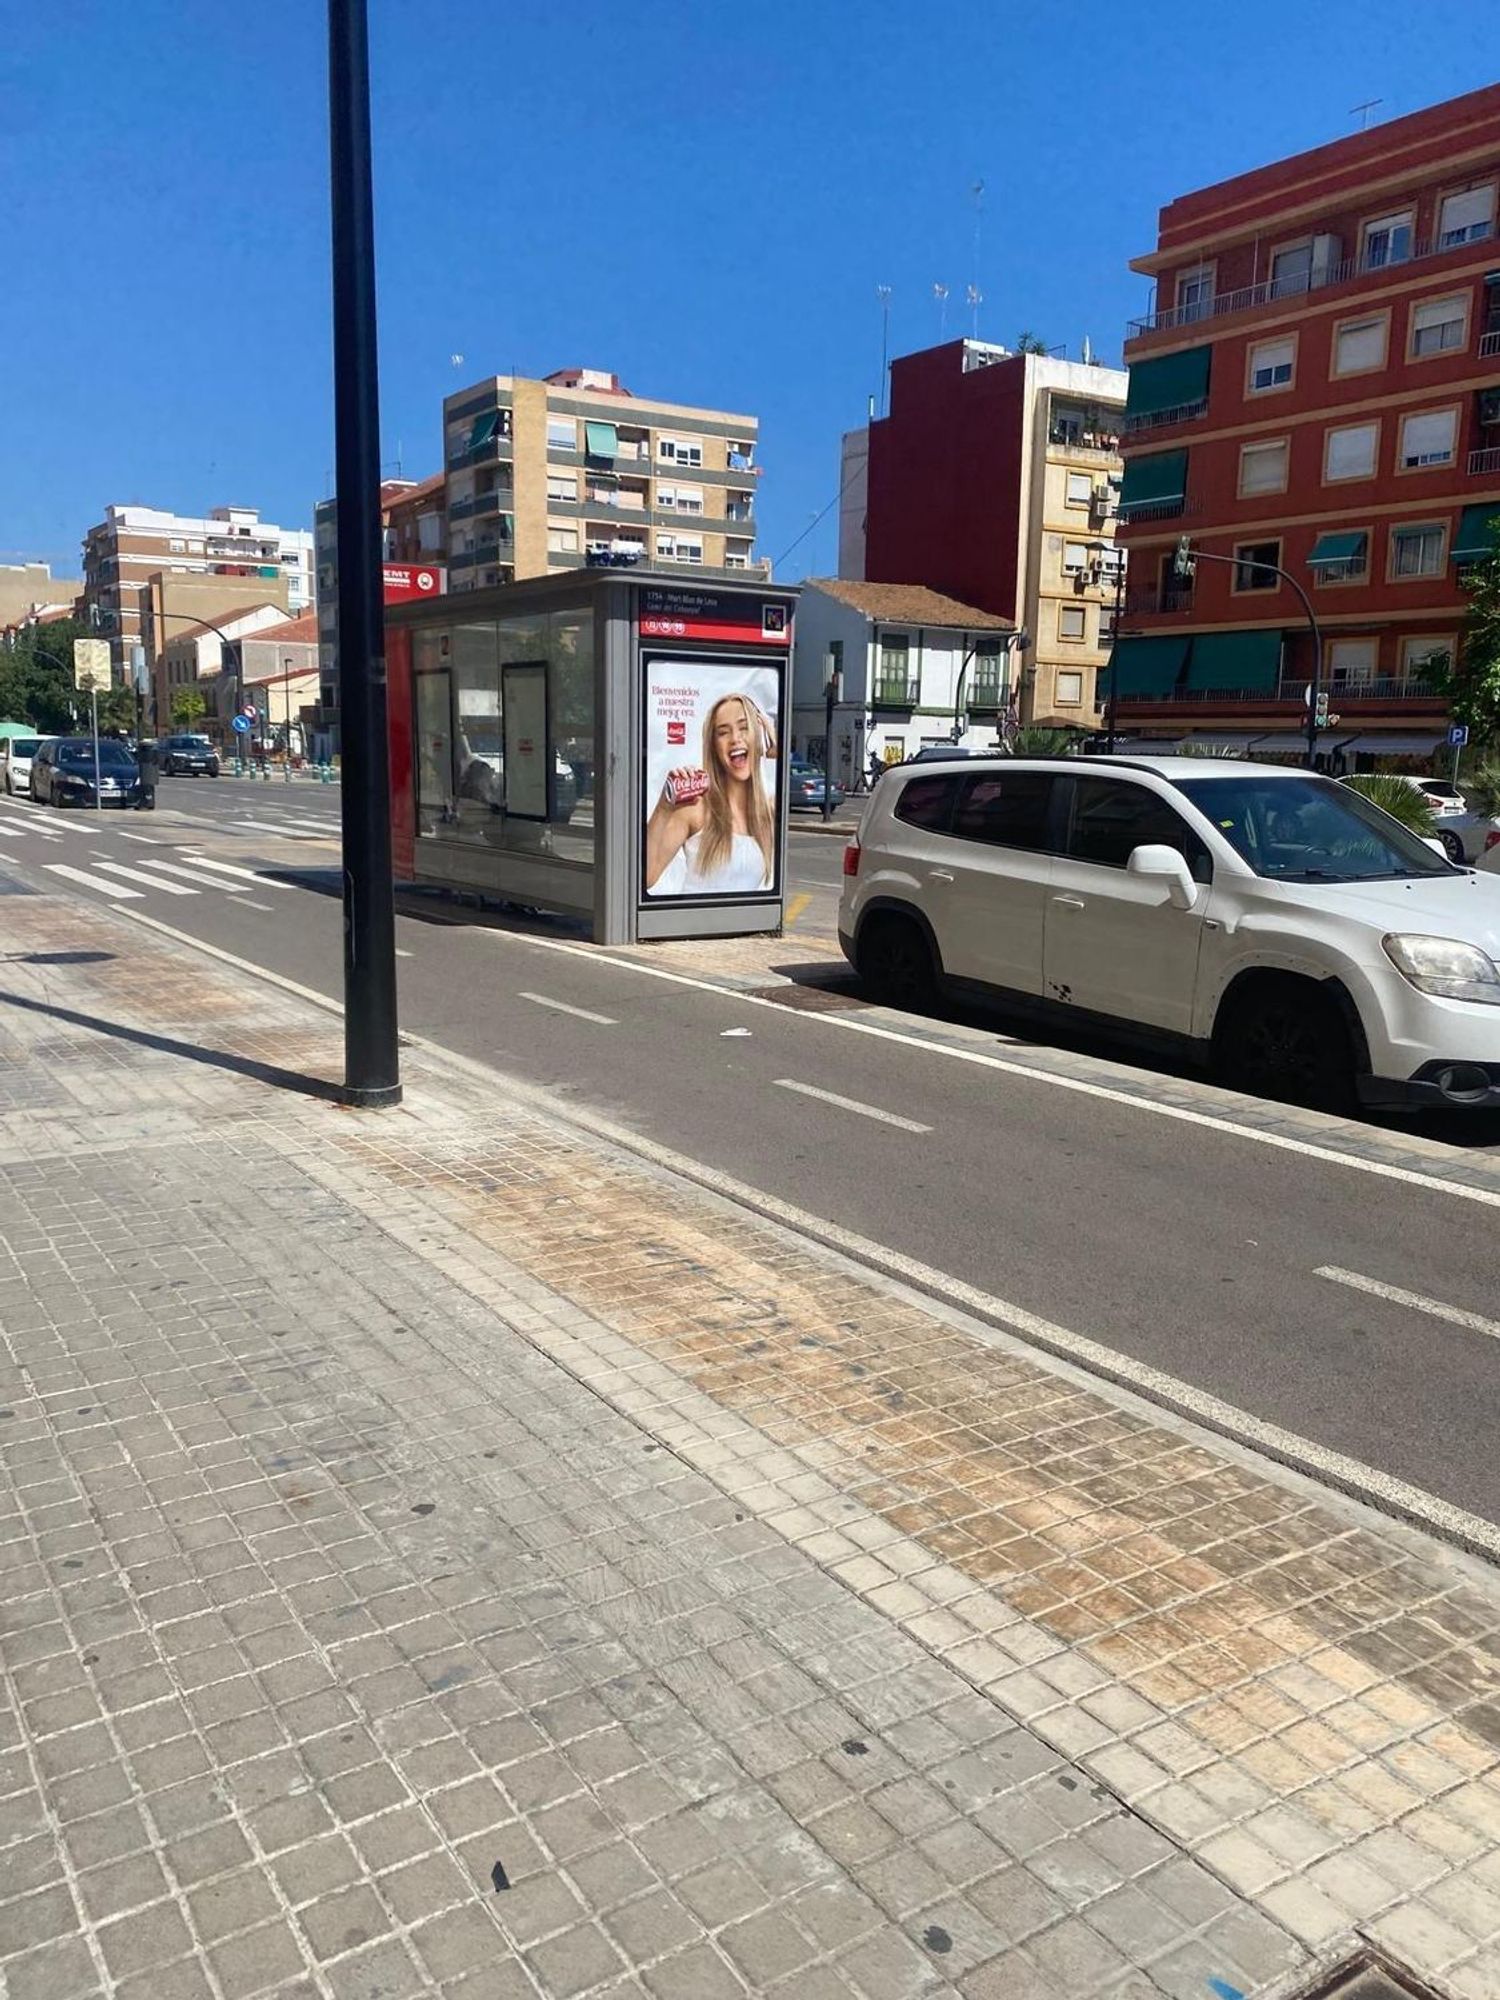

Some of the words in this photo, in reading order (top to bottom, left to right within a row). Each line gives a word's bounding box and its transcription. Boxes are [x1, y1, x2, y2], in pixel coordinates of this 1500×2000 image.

[652, 686, 700, 697] Bienvenidos
[664, 698, 694, 707] nuestra
[657, 708, 680, 719] mejor
[1452, 729, 1463, 742] P
